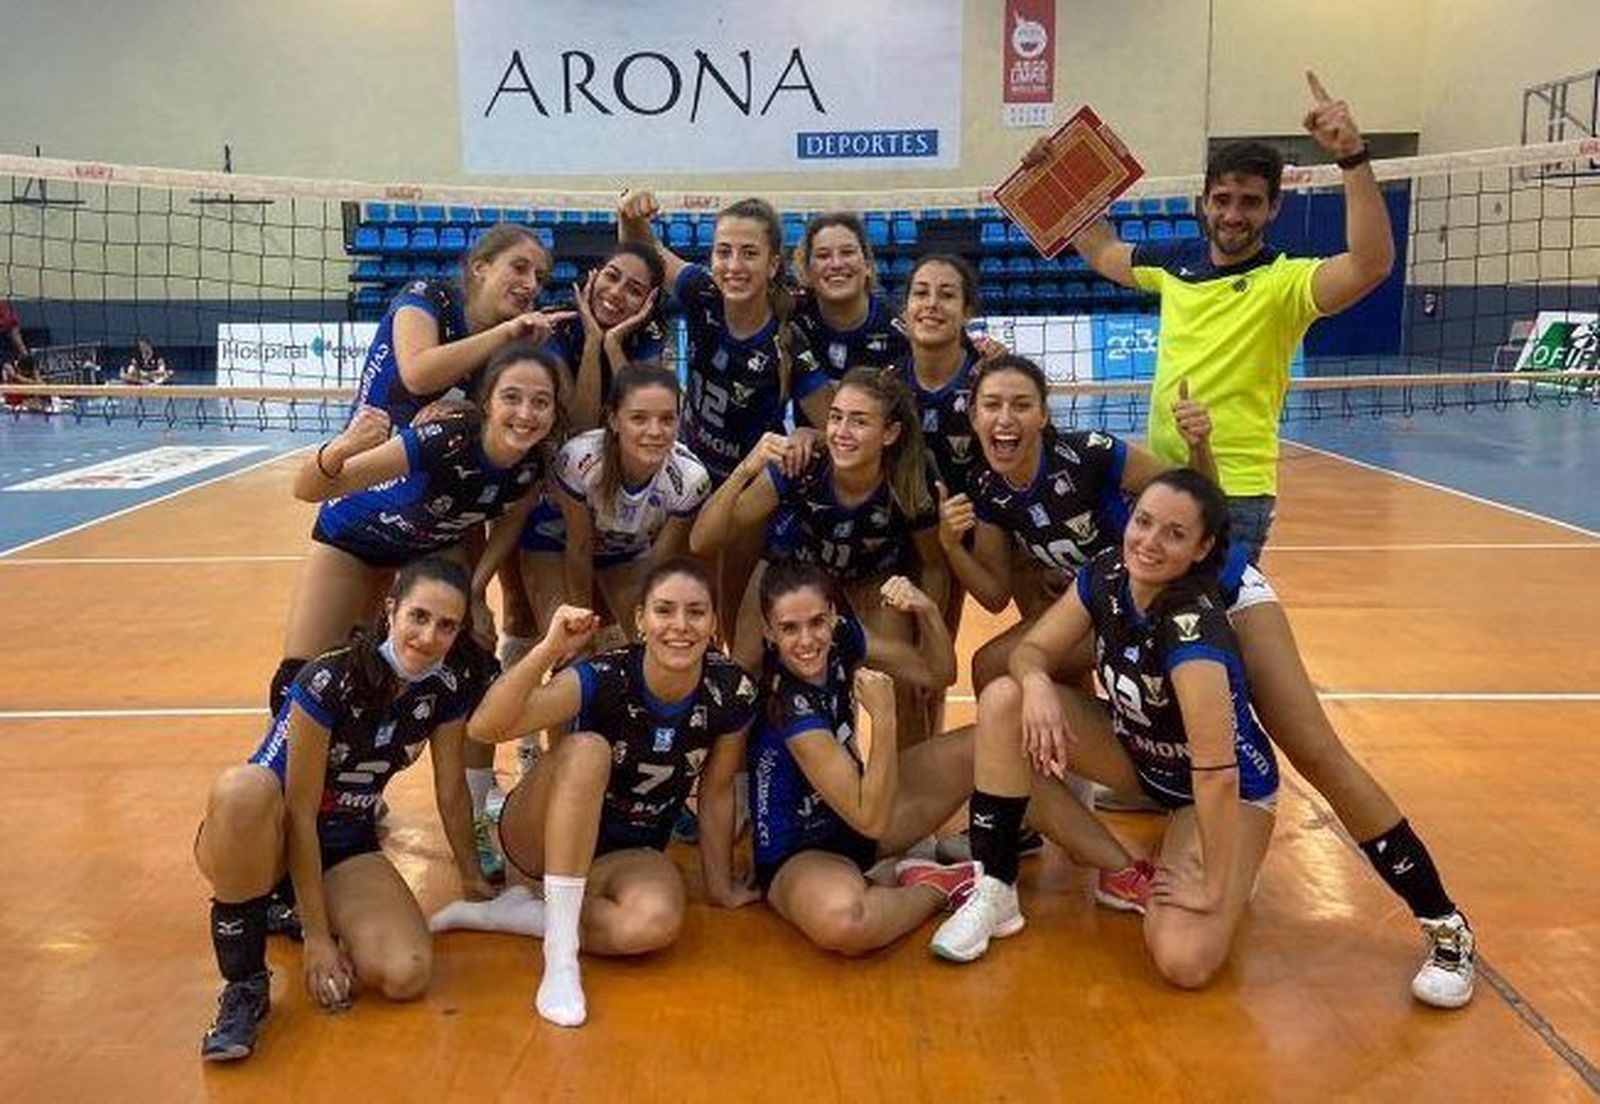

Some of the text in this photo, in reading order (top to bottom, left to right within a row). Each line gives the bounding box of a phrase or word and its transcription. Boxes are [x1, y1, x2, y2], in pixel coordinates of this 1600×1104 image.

[484, 49, 827, 124] ARONA
[806, 132, 927, 157] DEPORTES
[222, 341, 309, 363] Hospital
[631, 763, 676, 795] 7
